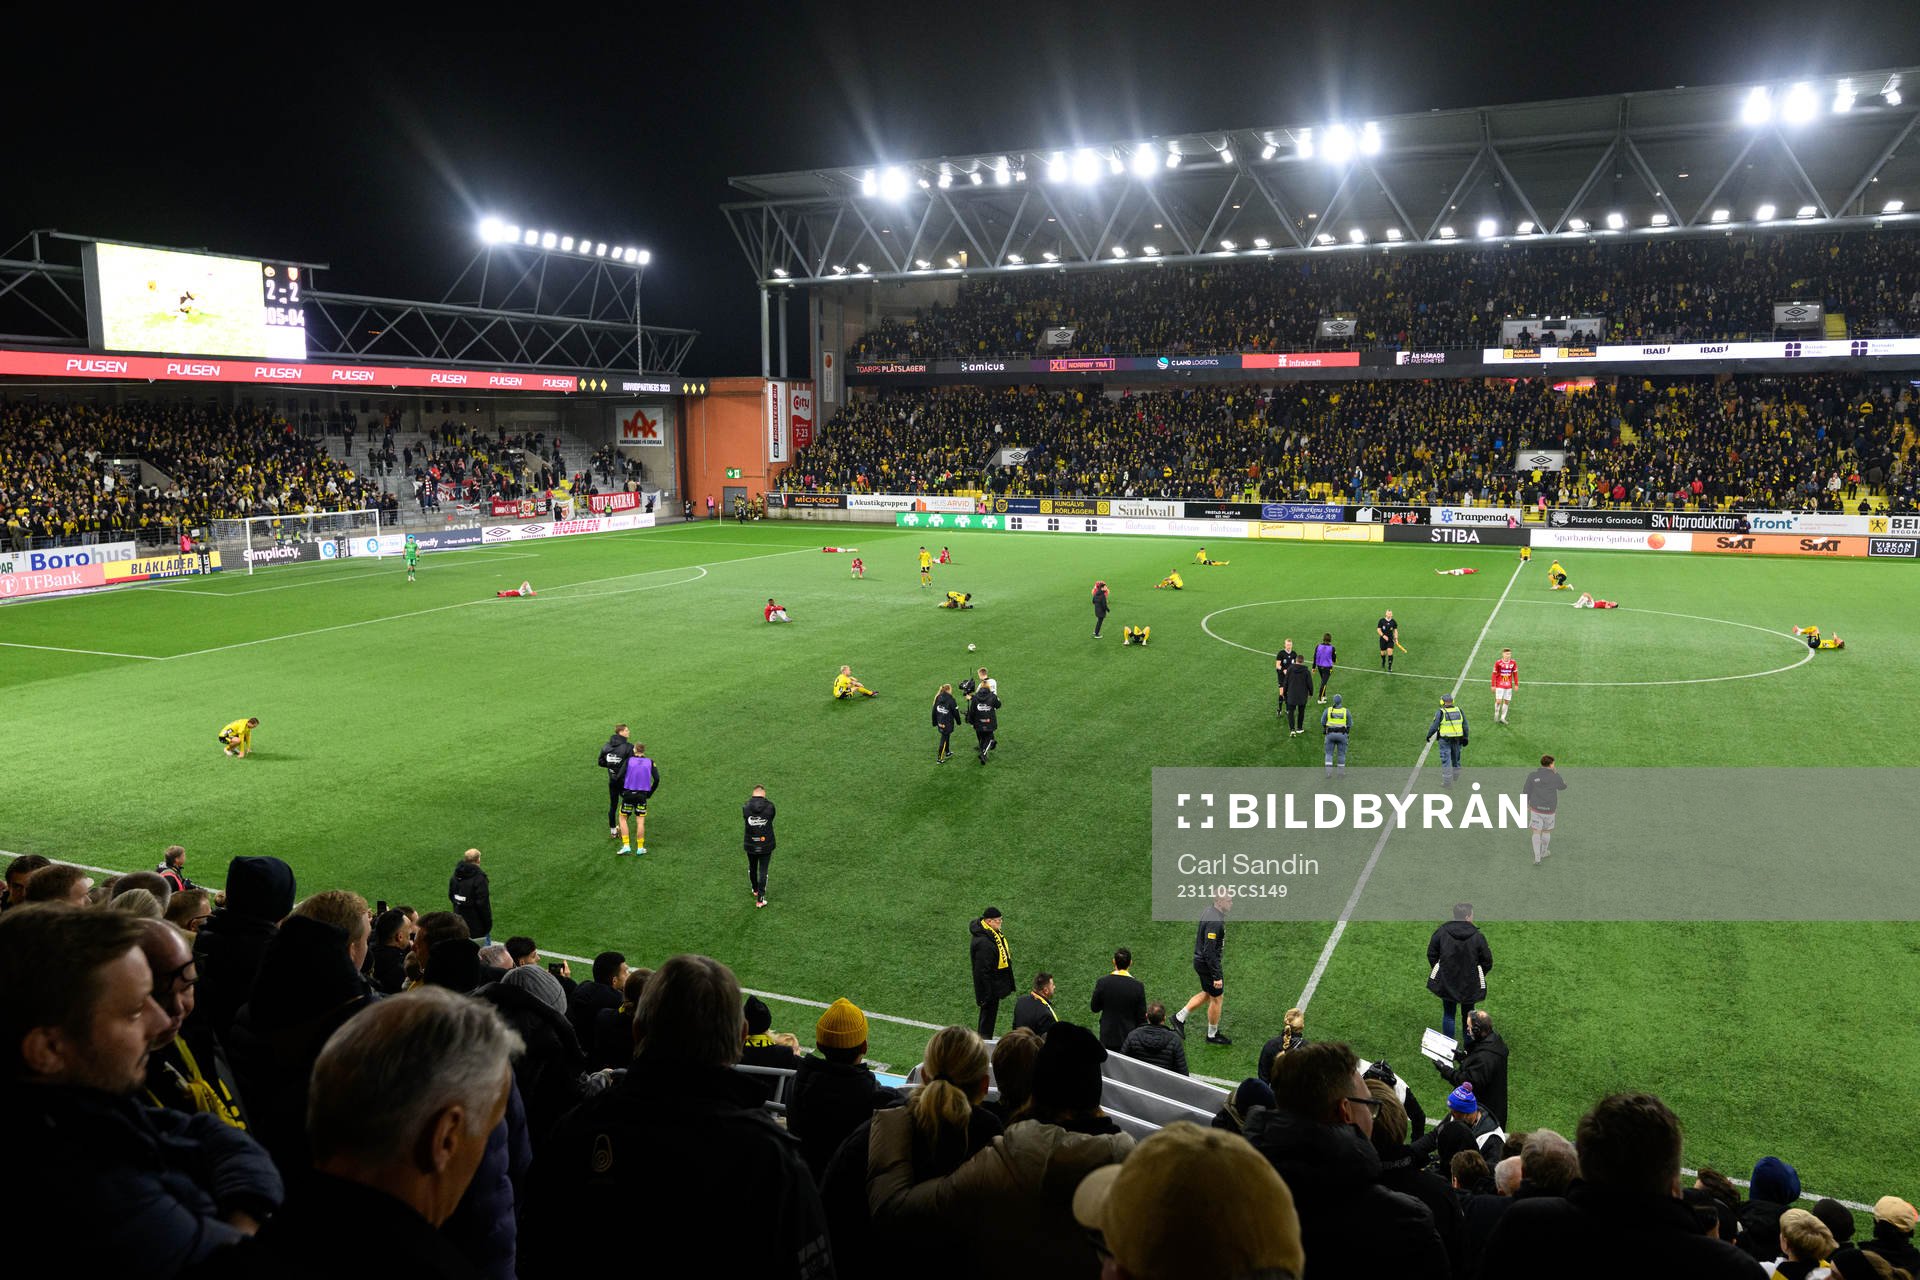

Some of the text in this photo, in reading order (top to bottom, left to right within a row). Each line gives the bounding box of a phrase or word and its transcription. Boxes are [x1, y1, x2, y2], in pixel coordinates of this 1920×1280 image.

[66, 359, 128, 373] PULSEN
[167, 363, 221, 376] PULSEN
[856, 363, 926, 373] TOARPS PLÅTSLAGERI
[969, 362, 1005, 371] amicus
[254, 367, 302, 379] PULSEN
[332, 369, 374, 381] PULSEN
[431, 373, 467, 384] PULSEN
[489, 376, 522, 386] PULSEN
[543, 378, 573, 388] PULSEN
[623, 409, 657, 438] MAX
[854, 498, 908, 509] Akustikgruppen
[1054, 507, 1095, 515] RÖRLÄGGERI
[1118, 504, 1175, 517] Sandwall
[1455, 512, 1509, 523] Tranpenad
[1571, 516, 1643, 524] Pizzeria Granada
[1651, 514, 1738, 530] Skyltproduktion
[1753, 517, 1793, 530] front
[552, 519, 600, 535] MOBILEN
[1431, 528, 1480, 543] STIBA
[30, 547, 132, 571] Borohus
[131, 556, 194, 575] BLÅKLÄDER
